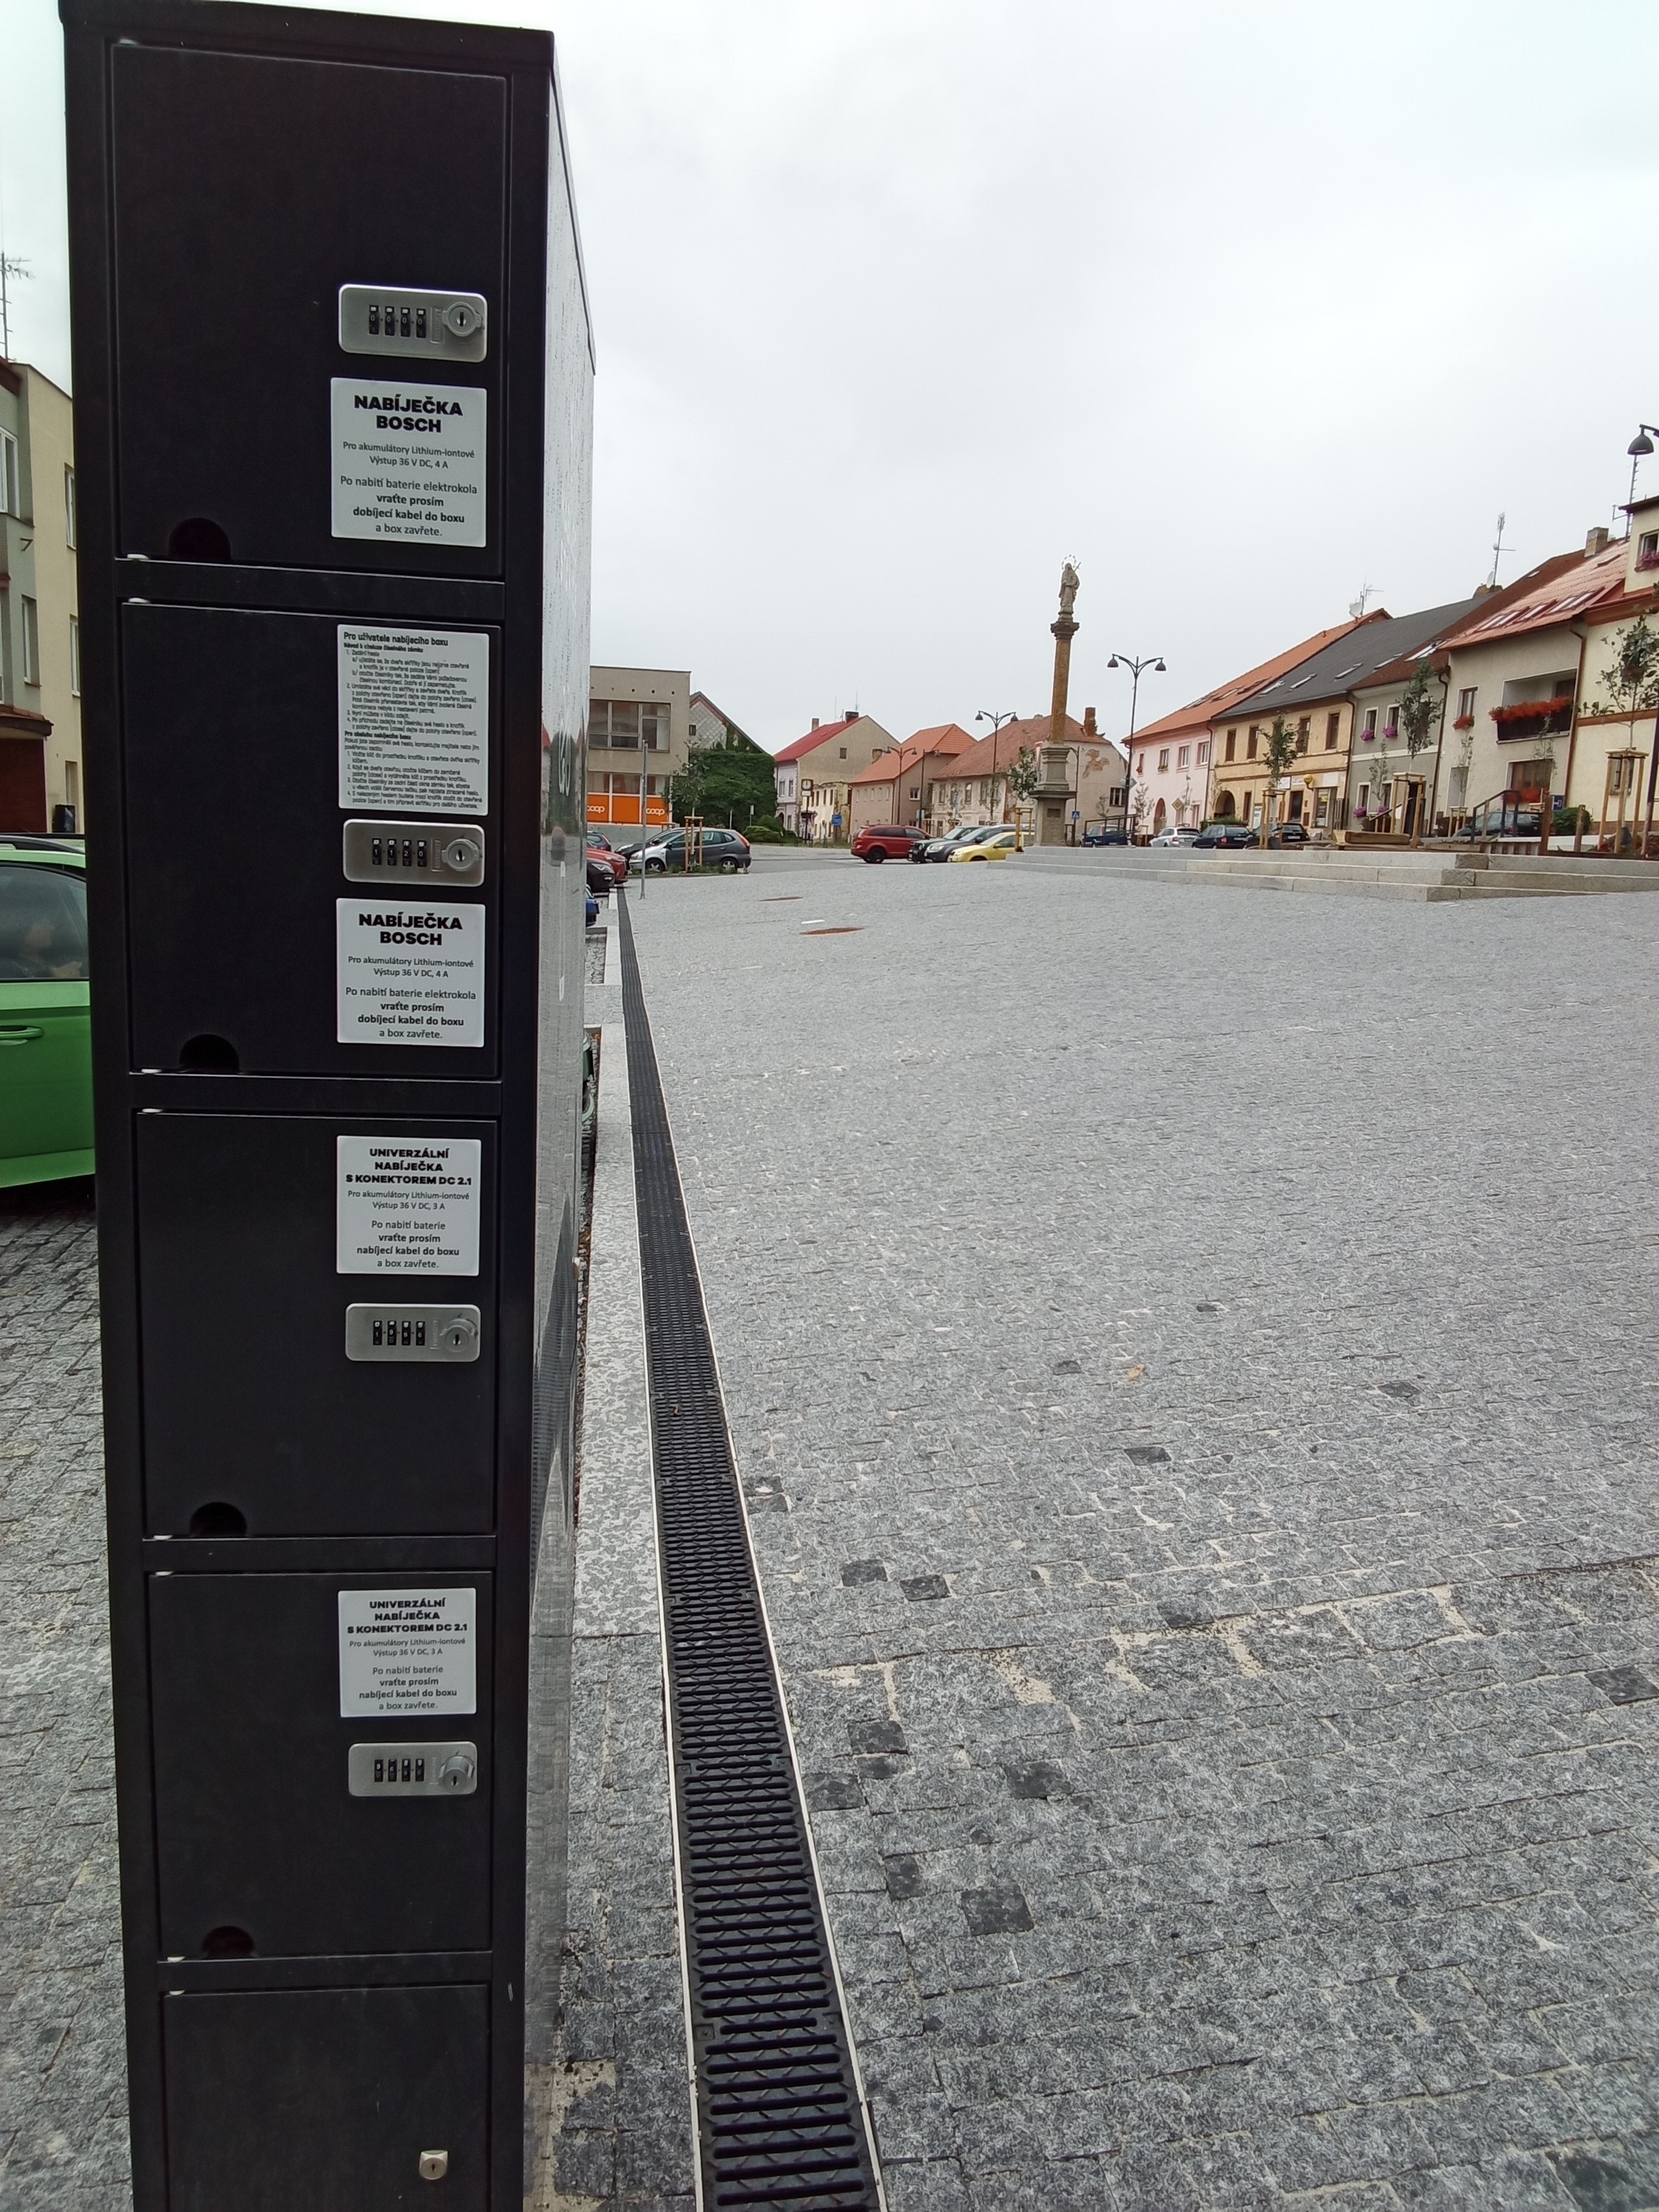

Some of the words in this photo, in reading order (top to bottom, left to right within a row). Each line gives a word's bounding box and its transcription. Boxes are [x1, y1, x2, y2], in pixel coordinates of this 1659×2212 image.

[354, 394, 463, 416] NABÍJEČKA
[376, 415, 441, 433] BOSCH
[343, 441, 356, 450] Pro
[359, 442, 409, 455] akumulátory
[369, 455, 397, 466] Výstup
[399, 457, 409, 466] 36
[411, 458, 417, 466] V
[419, 459, 433, 469] DC,
[442, 460, 449, 468] A
[340, 475, 352, 485] Po
[355, 477, 384, 487] nabití
[386, 478, 420, 490] baterie
[423, 481, 477, 494] elektrokola
[376, 493, 407, 504] vraťte
[409, 496, 444, 506] prosím
[353, 506, 393, 519] dobíjecí
[395, 508, 422, 520] kabel
[425, 511, 438, 520] do
[440, 512, 464, 523] boxu
[384, 523, 402, 533] box
[404, 525, 442, 536] zavřete.
[344, 631, 356, 640] Pro
[358, 632, 390, 642] uživatele
[392, 635, 429, 645] nabíjecího
[430, 637, 448, 646] boxu
[646, 808, 665, 816] coop
[359, 912, 463, 930] NABÍJEČKA
[380, 931, 442, 945] BOSCH
[363, 956, 412, 966] akumulátory
[373, 968, 400, 977] Výstup
[421, 969, 434, 978] DC,
[346, 987, 357, 996] Po
[360, 987, 387, 996] nabití
[389, 987, 422, 998] baterie
[424, 989, 476, 1000] elektrokola
[380, 1001, 409, 1010] vraťte
[411, 1003, 444, 1012] prosím
[358, 1014, 396, 1025] dobíjecí
[398, 1015, 424, 1024] kabel
[426, 1016, 438, 1025] do
[441, 1017, 464, 1025] boxu
[387, 1028, 404, 1037] box
[406, 1029, 443, 1038] zavřete.
[369, 1147, 449, 1158] UNIVERZÁLNÍ
[375, 1160, 443, 1171] NABÍJEČKA
[346, 1174, 353, 1183] S
[355, 1174, 436, 1184] KONEKTOREM
[438, 1176, 455, 1185] DC
[457, 1176, 471, 1185] 2.1
[362, 1190, 410, 1200] akumulátory
[372, 1201, 398, 1210] Výstup
[418, 1202, 431, 1210] DC,
[371, 1220, 383, 1228] Po
[385, 1220, 411, 1229] nabití
[413, 1221, 445, 1230] baterie
[378, 1232, 407, 1242] vraťte
[409, 1233, 441, 1244] prosím
[356, 1246, 393, 1256] nabíjecí
[395, 1246, 420, 1254] kabel
[422, 1246, 434, 1255] do
[437, 1246, 459, 1255] boxu
[385, 1258, 401, 1267] box
[403, 1259, 438, 1268] zavřete.
[369, 1597, 446, 1609] UNIVERZÁLNÍ
[374, 1610, 441, 1621] NABÍJEČKA
[356, 1624, 434, 1633] KONEKTOREM
[454, 1623, 467, 1631] 2.1
[363, 1639, 409, 1647] akumulátory
[373, 1649, 397, 1657] Výstup
[385, 1665, 411, 1675] nabití
[413, 1665, 443, 1674] baterie
[380, 1677, 406, 1686] vraťte
[408, 1677, 438, 1687] prosím
[359, 1689, 394, 1700] nabíjecí
[396, 1689, 419, 1698] kabel
[422, 1689, 433, 1697] do
[435, 1688, 457, 1696] boxu
[386, 1702, 402, 1710] box
[404, 1700, 438, 1709] zavřete.
